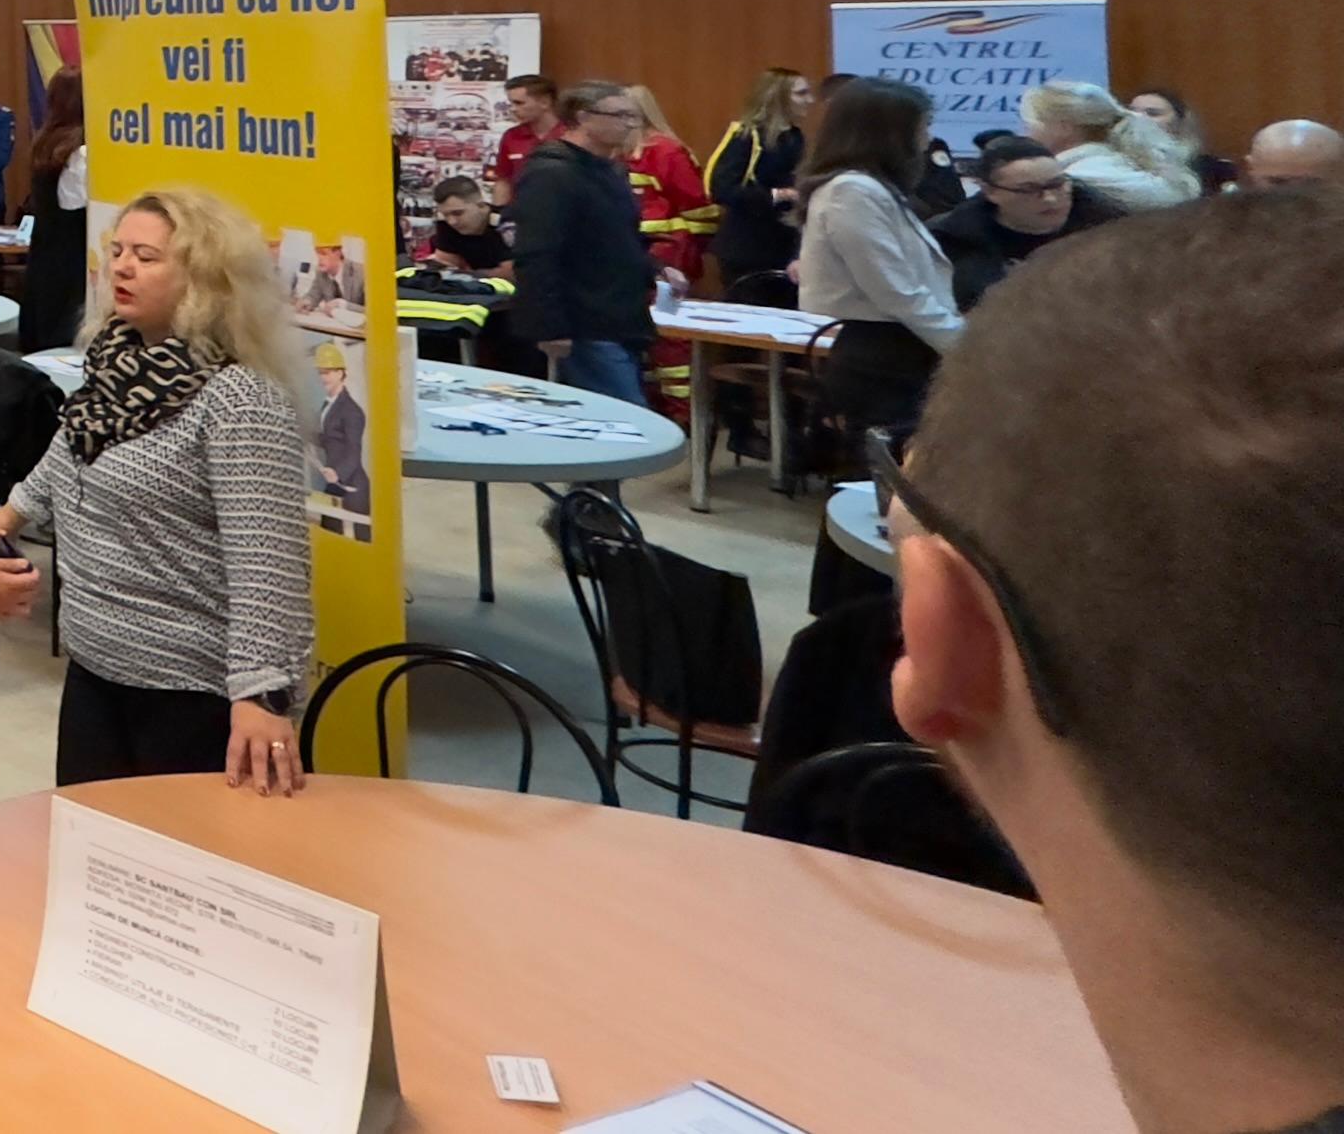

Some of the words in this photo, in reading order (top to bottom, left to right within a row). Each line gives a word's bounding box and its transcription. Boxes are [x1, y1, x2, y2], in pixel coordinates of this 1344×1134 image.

[161, 38, 211, 82] vei
[222, 38, 245, 83] fi
[880, 41, 1051, 59] CENTRUL
[877, 68, 1062, 85] EDUCATIV
[110, 103, 150, 145] cel
[163, 106, 224, 151] mai
[238, 107, 316, 159] bun!
